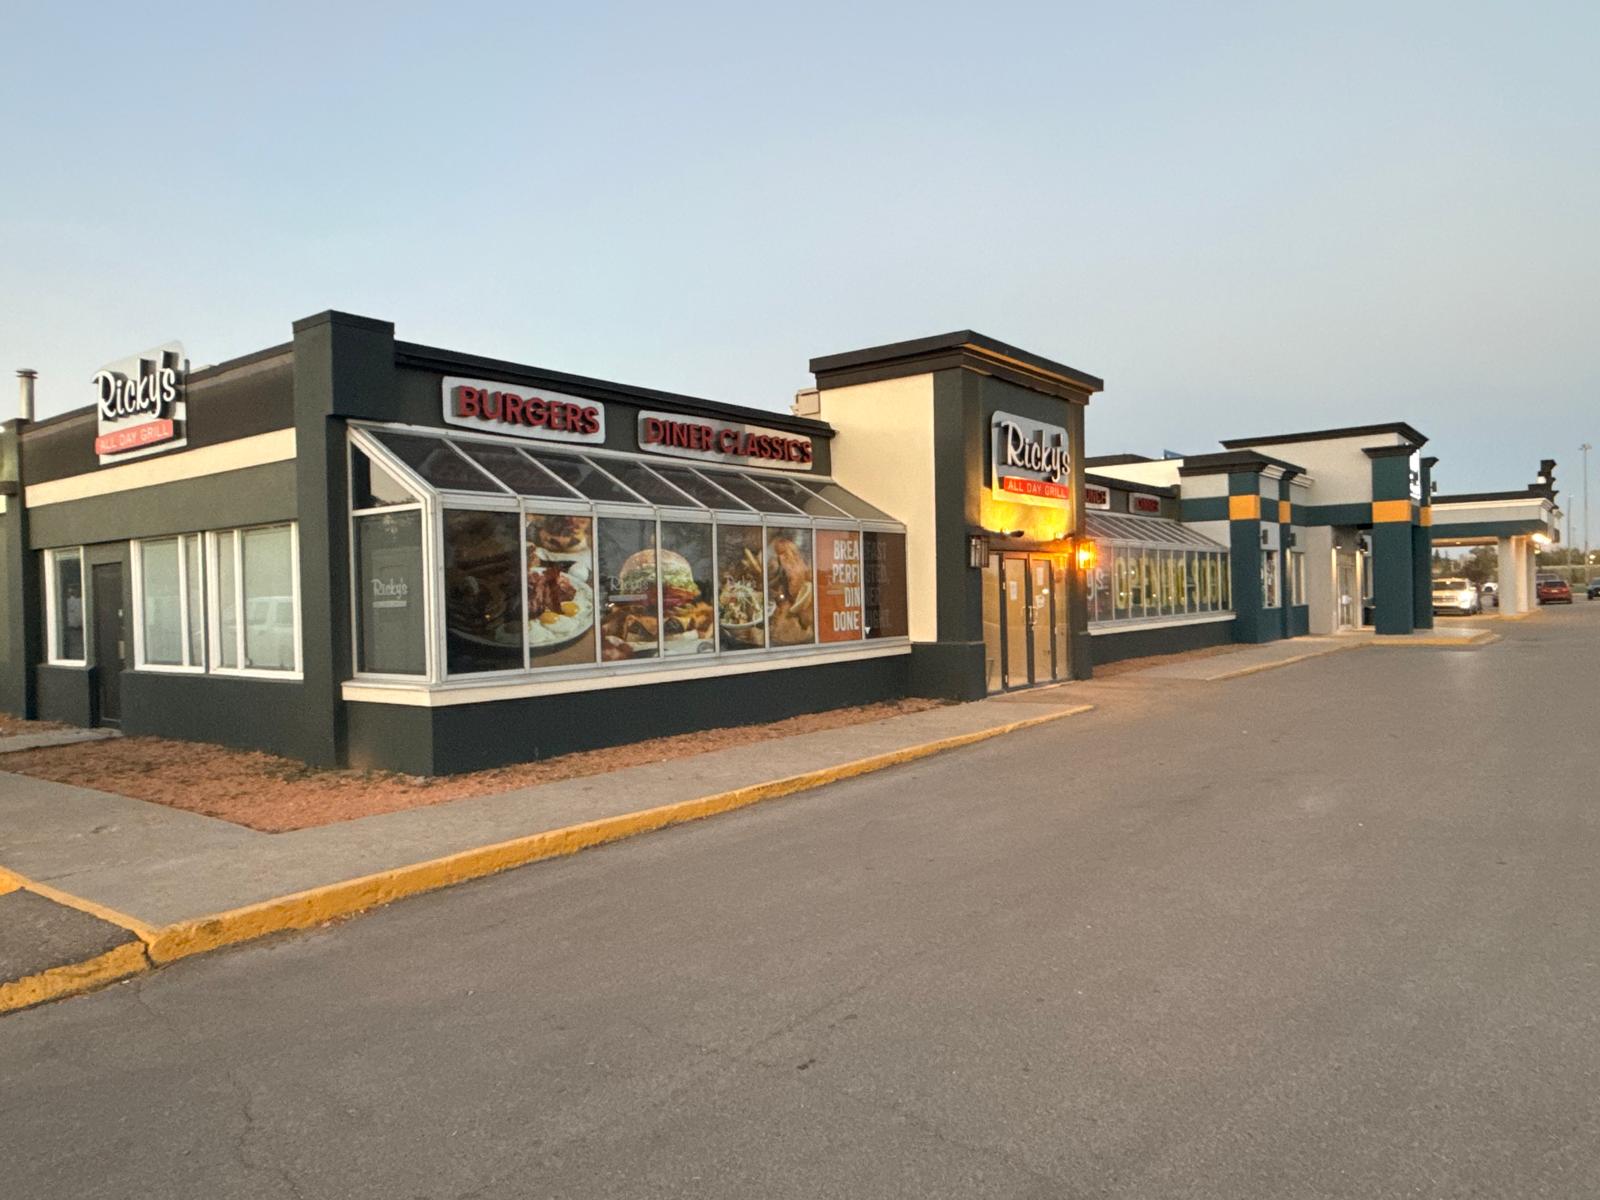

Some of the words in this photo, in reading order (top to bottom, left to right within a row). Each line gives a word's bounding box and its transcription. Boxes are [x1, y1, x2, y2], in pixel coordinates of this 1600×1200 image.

[92, 350, 175, 420] Ricky's
[457, 385, 600, 434] BURGERS
[101, 438, 117, 450] ALL
[119, 432, 137, 447] DAY
[141, 423, 169, 442] GRILL
[645, 417, 714, 450] DINER
[719, 428, 812, 463] CLASSICS
[1001, 421, 1070, 483] Ricky's
[1008, 480, 1024, 492] ALL
[1026, 483, 1042, 494] DAY
[1044, 485, 1067, 498] GRILL
[832, 610, 860, 632] DONE
